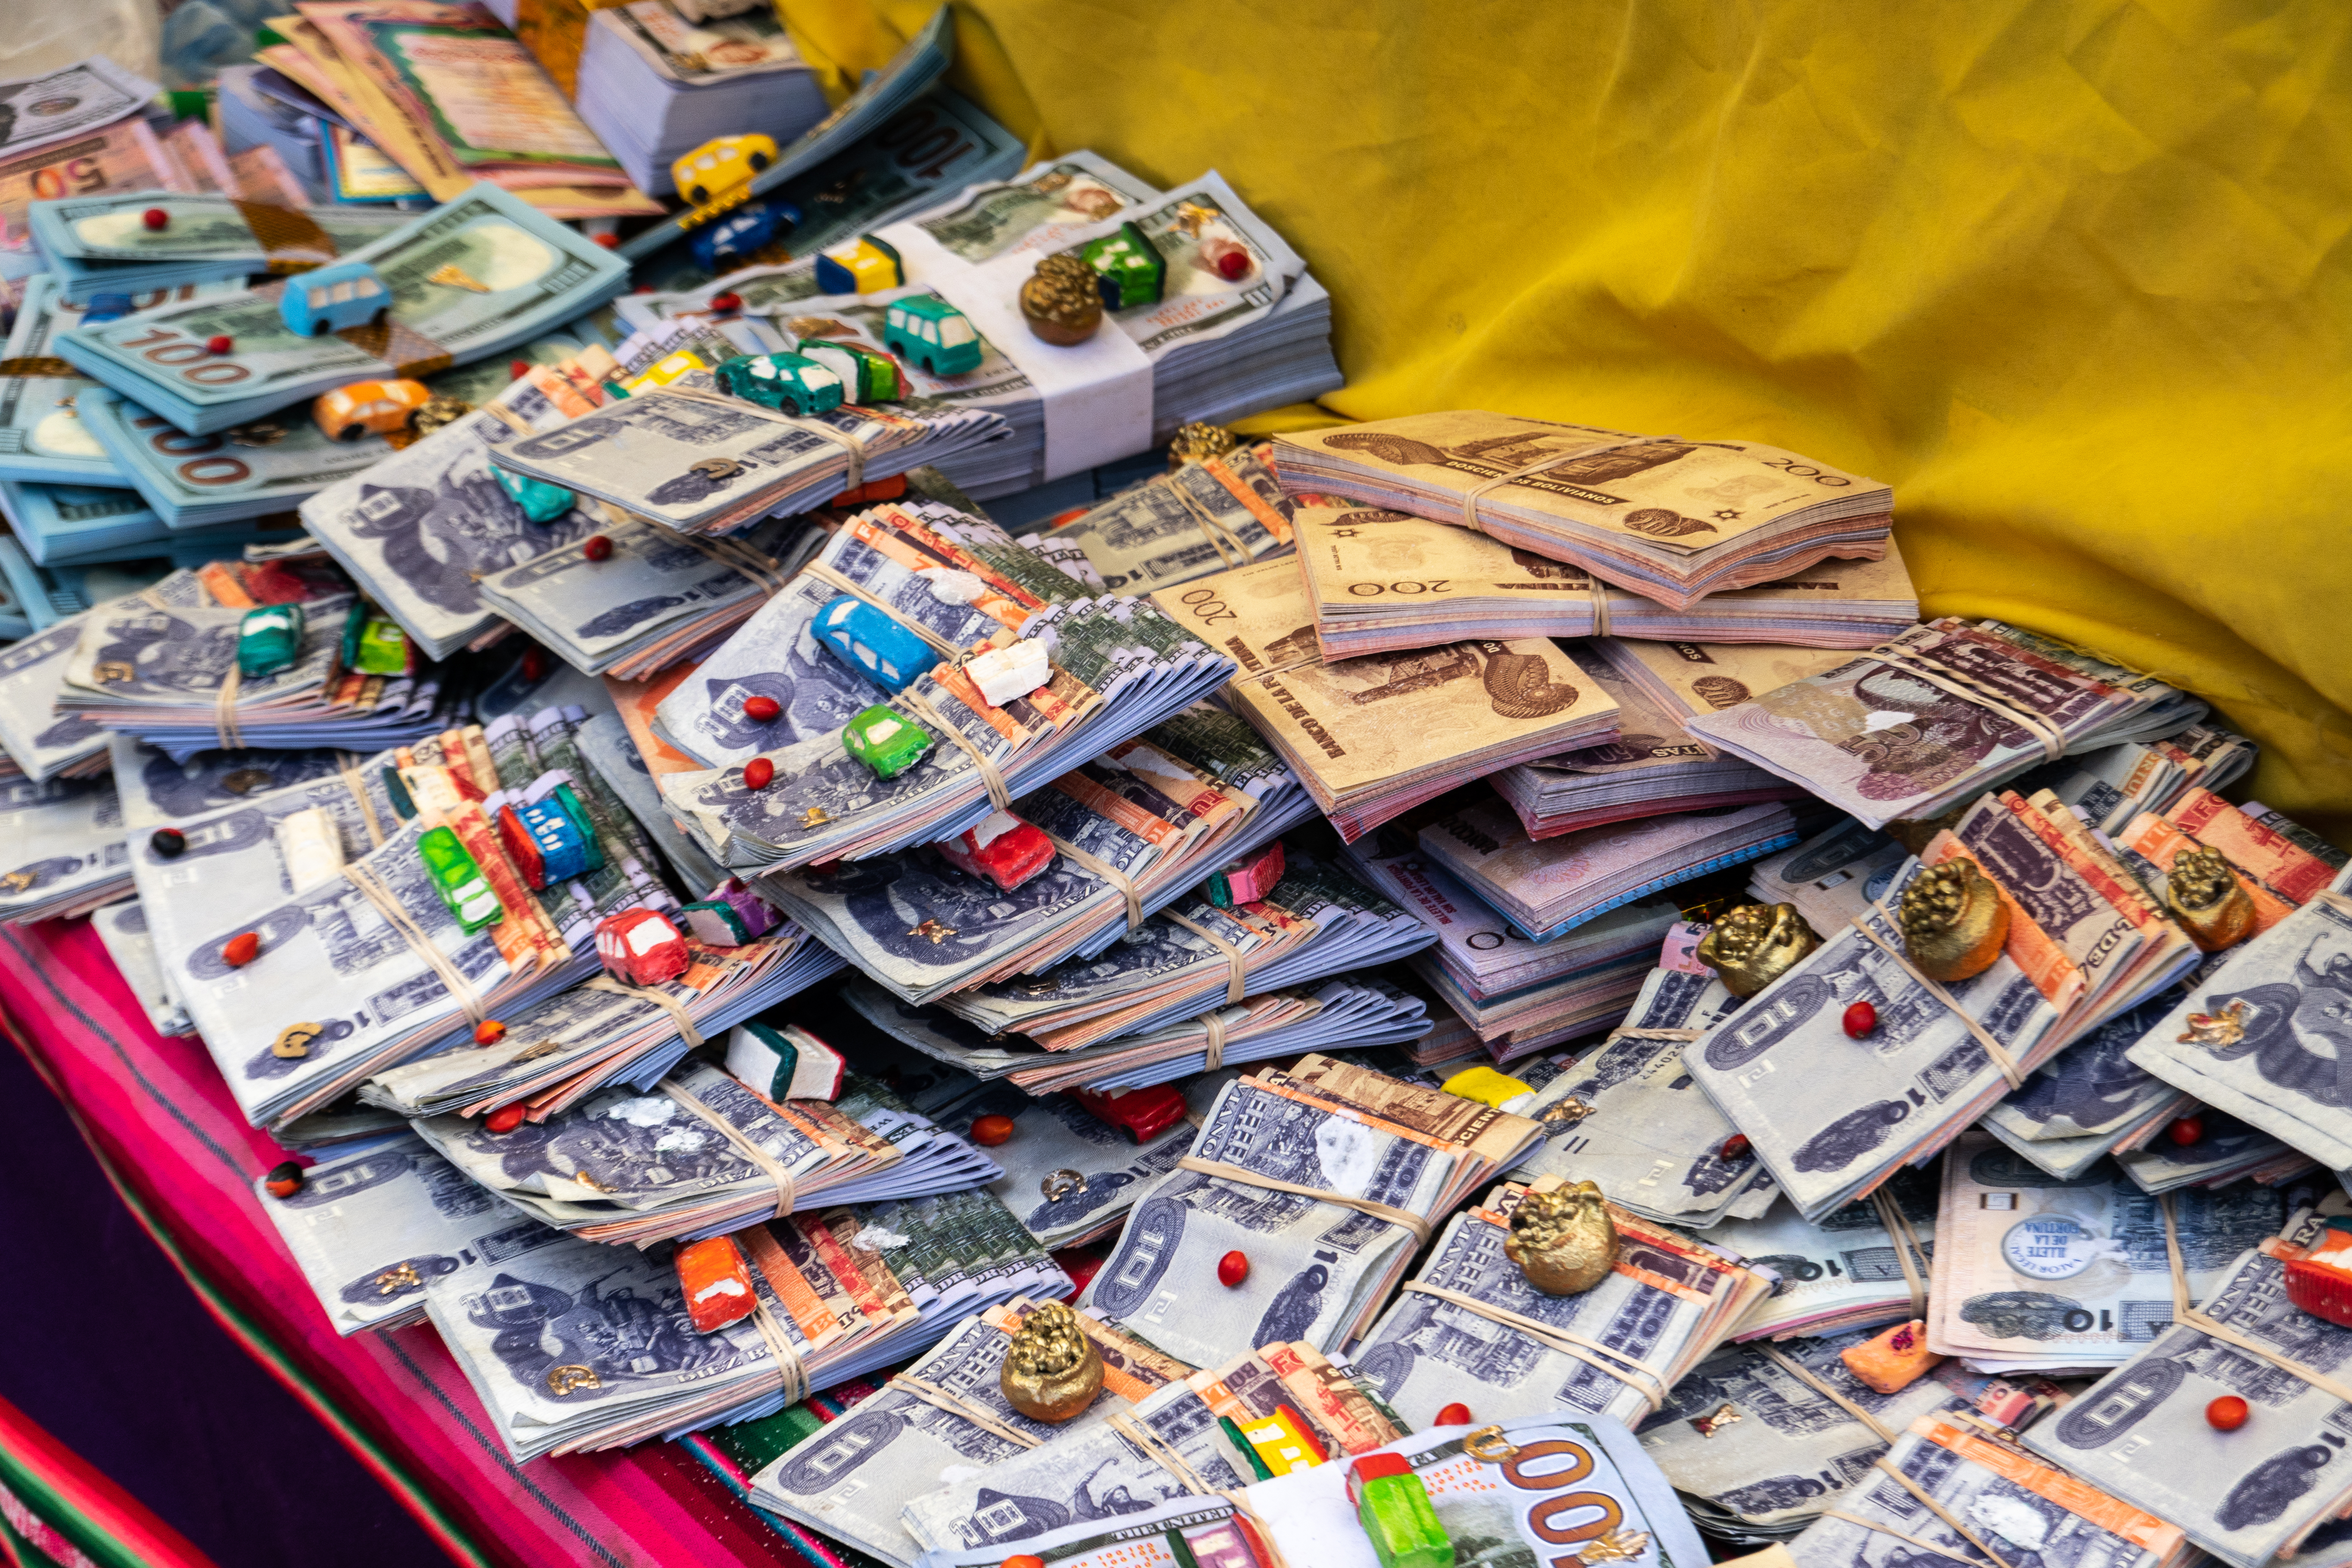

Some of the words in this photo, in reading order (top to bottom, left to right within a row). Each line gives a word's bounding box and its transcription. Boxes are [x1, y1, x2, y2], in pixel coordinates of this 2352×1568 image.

[121, 328, 251, 385] 100
[1445, 460, 1528, 484] DOSCIENOS
[1527, 478, 1615, 505] BOLIVIANOS
[1761, 457, 1851, 487] 200
[1348, 579, 1453, 597] 200
[1181, 589, 1238, 626] 200
[1225, 635, 1277, 693] FOTUNA
[1273, 688, 1295, 709] LA
[1286, 701, 1309, 723] DE
[1300, 717, 1347, 760] BANCO
[1835, 723, 1923, 763] 50
[1386, 864, 1417, 890] FORTUNA
[1410, 888, 1424, 897] LA
[1041, 883, 1099, 918] DIEZ
[1417, 896, 1432, 905] DE
[1423, 885, 1448, 905] VALOR
[1440, 903, 1458, 914] SIN
[1424, 904, 1453, 925] BILLETE
[1143, 952, 1203, 978] DIEZ
[329, 1011, 371, 1040] 10
[1737, 999, 1797, 1048] 10
[1885, 1087, 1926, 1125] 10
[314, 1164, 377, 1196] 10
[435, 1249, 477, 1275] 10
[1115, 1229, 1167, 1289] 10
[1306, 1249, 1341, 1292] 10
[1793, 1259, 1842, 1282] 10
[459, 1285, 533, 1316] 10
[2064, 1309, 2113, 1333] 10
[677, 1356, 742, 1383] DIEZ
[2084, 1380, 2151, 1427] 10
[806, 1431, 873, 1476] 10
[2306, 1430, 2347, 1468] 10
[949, 1498, 1028, 1547] 10
[1112, 1524, 1156, 1540] THE
[1156, 1506, 1234, 1531] UNITED
